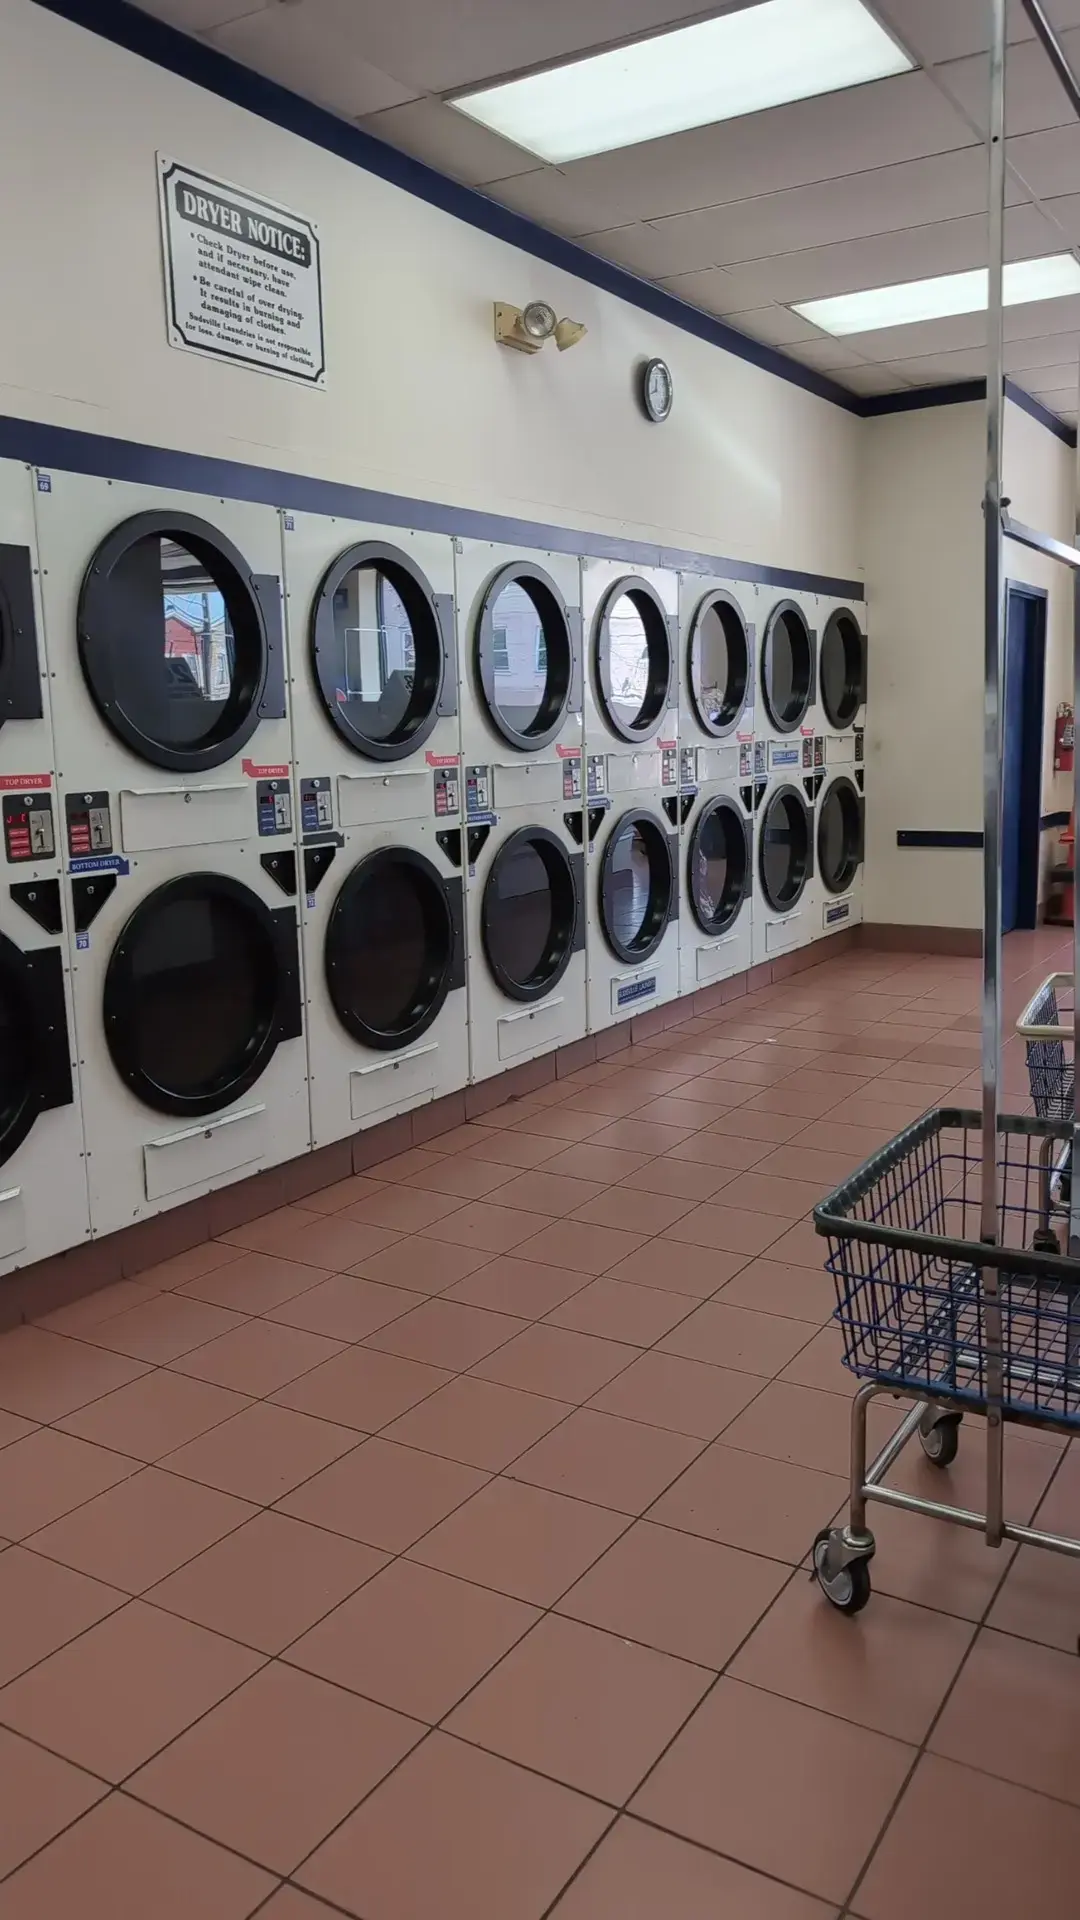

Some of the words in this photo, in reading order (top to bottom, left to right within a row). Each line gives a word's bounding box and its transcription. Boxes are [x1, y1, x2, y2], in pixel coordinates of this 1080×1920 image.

[183, 190, 242, 235] DRYER
[247, 216, 305, 260] NOTICE:
[197, 233, 223, 251] Check
[226, 245, 250, 261] Dryer
[253, 255, 278, 272] before
[197, 248, 213, 259] and
[217, 252, 223, 263] if
[272, 274, 290, 288] have
[199, 260, 239, 280] attendant
[242, 276, 261, 288] wipe
[264, 284, 287, 297] clean.
[199, 276, 211, 287] Be
[214, 284, 244, 299] careful
[247, 294, 255, 302] of
[259, 299, 275, 309] over
[200, 287, 207, 298] It
[211, 293, 240, 309] results
[242, 302, 251, 312] in
[254, 306, 284, 325] burning
[287, 320, 301, 329] and
[200, 300, 242, 323] damaging
[245, 316, 253, 324] of
[256, 319, 286, 335] clothes.
[185, 321, 196, 330] for
[255, 343, 280, 358] burning
[223, 322, 256, 339] Laundries
[257, 333, 264, 341] is
[277, 341, 311, 357] responsible
[20, 777, 43, 785] DRYER
[71, 862, 99, 870] BOTTOM
[100, 859, 120, 867] DRYER
